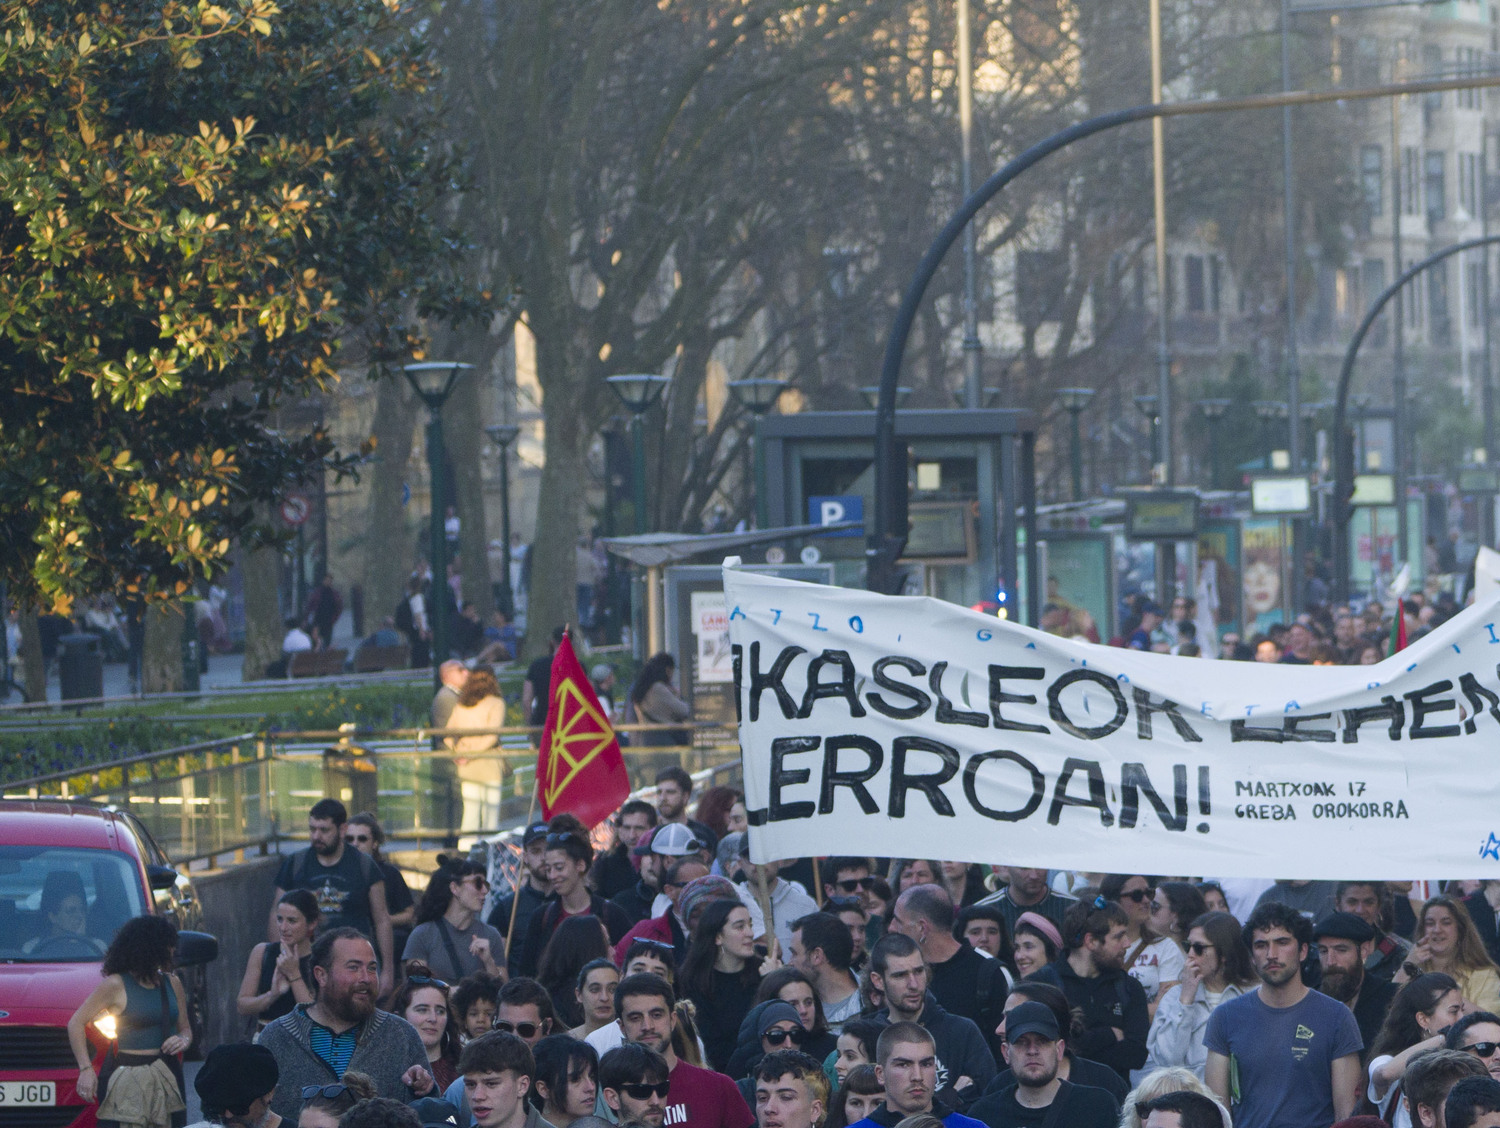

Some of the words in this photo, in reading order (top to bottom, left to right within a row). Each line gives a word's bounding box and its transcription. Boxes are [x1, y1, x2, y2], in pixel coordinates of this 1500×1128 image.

[820, 501, 845, 527] P
[1234, 780, 1336, 798] MARTXOAK
[1348, 781, 1367, 798] 17
[1234, 803, 1297, 821] GREBA
[1312, 799, 1410, 820] OROKORRA
[14, 1084, 52, 1103] JGD
[664, 1103, 687, 1126] TIN
